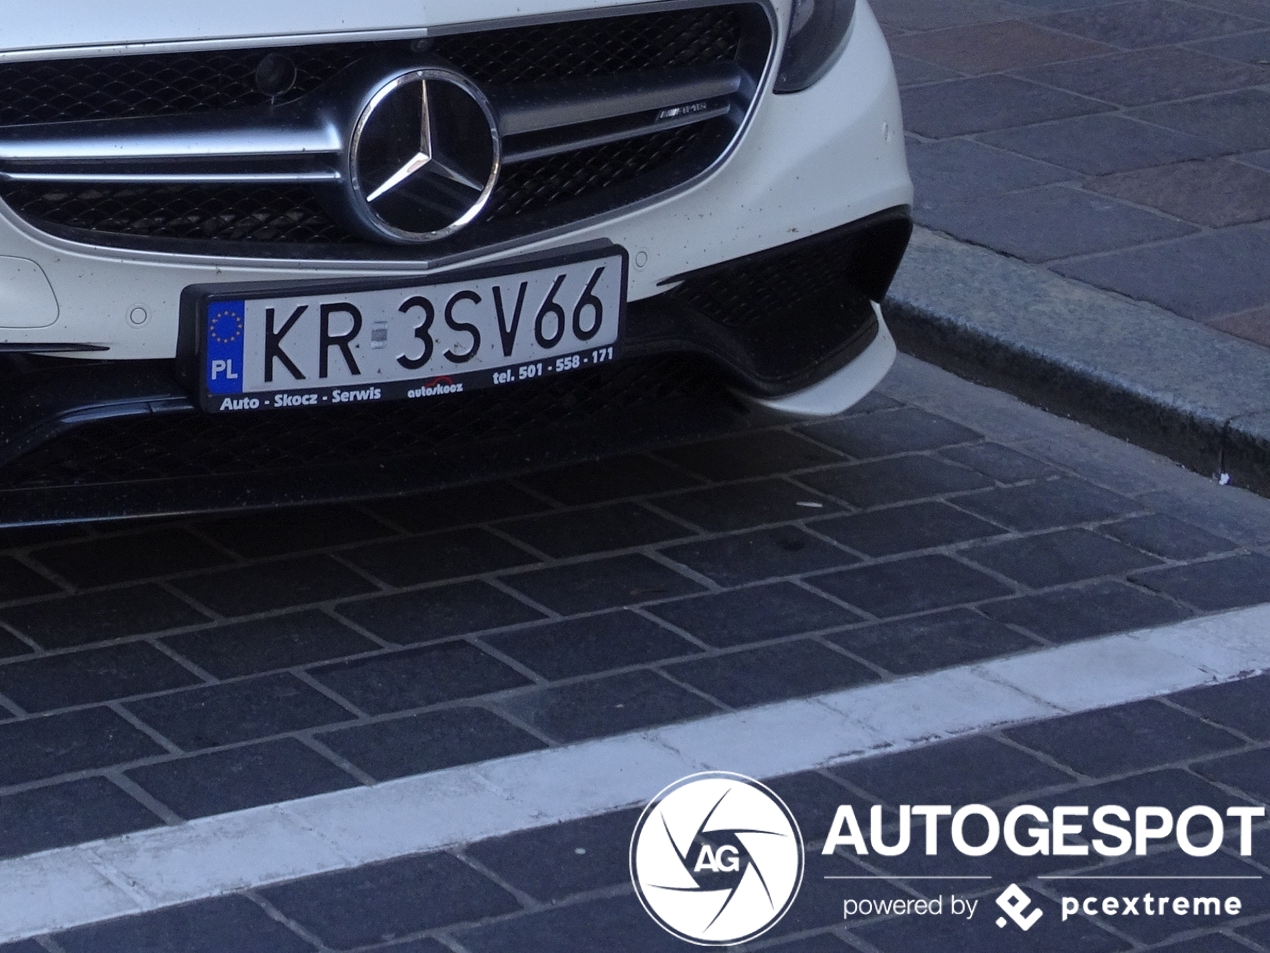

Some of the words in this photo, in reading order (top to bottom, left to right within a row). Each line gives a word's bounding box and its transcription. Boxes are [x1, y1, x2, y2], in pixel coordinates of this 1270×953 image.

[264, 301, 363, 383] KR
[396, 266, 605, 370] 3SV66
[211, 359, 238, 380] PL
[493, 369, 515, 385] tel.
[518, 363, 543, 380] 501
[556, 354, 581, 373] 558
[592, 347, 614, 364] 171
[220, 397, 260, 411] Auto
[274, 393, 318, 408] Skocz
[332, 386, 382, 404] Serwis
